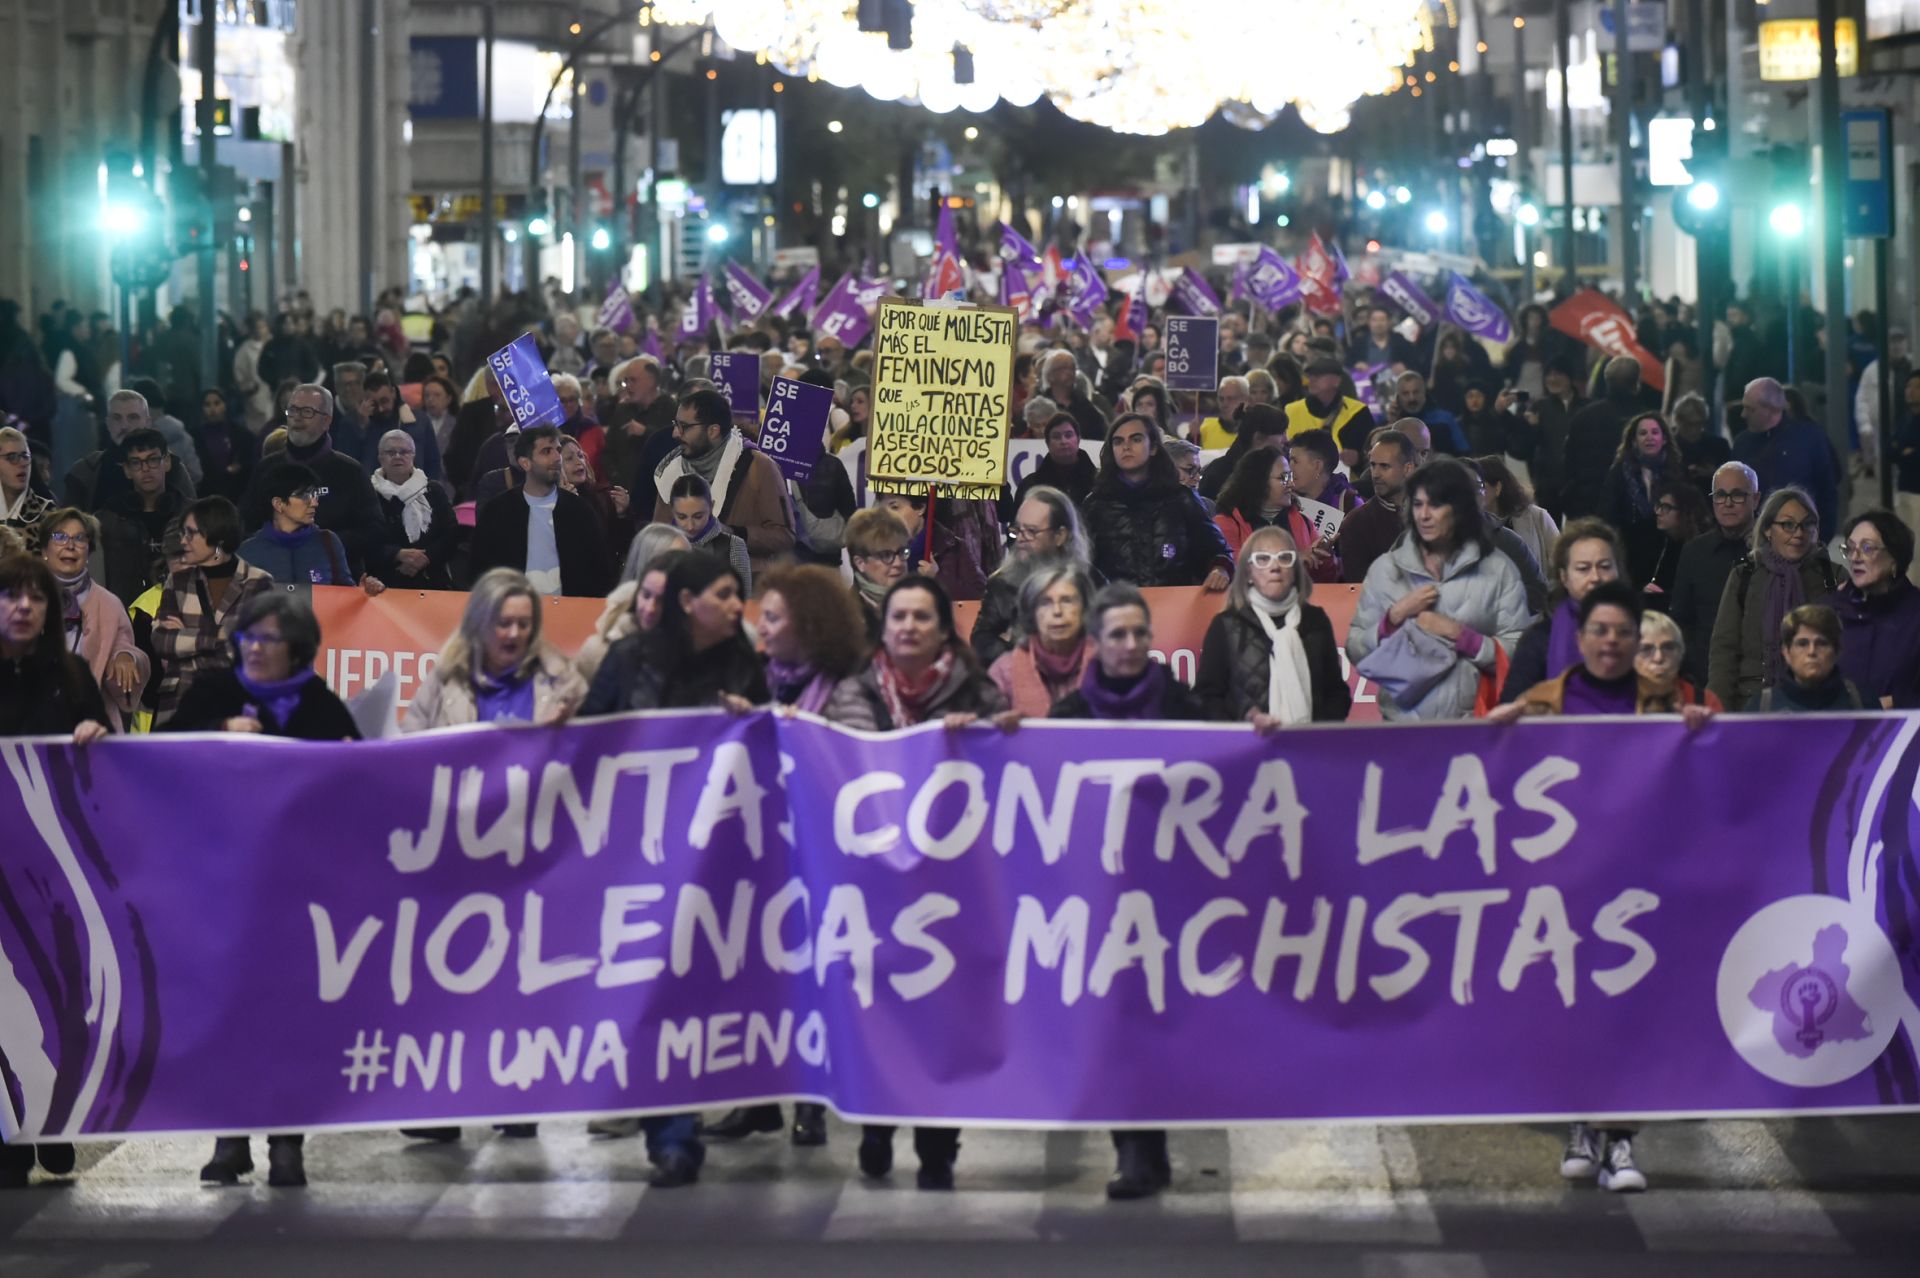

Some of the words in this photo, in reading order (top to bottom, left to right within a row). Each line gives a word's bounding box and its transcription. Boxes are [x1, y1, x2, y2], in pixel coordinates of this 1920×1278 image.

[881, 304, 916, 330] ¿POR
[919, 311, 941, 332] QUÉ
[944, 314, 1012, 346] MOLESTA
[1169, 320, 1188, 332] SE
[879, 331, 908, 355] MÁS
[914, 335, 937, 354] EL
[1168, 334, 1180, 346] A
[493, 351, 514, 372] SE
[713, 354, 731, 367] SE
[1168, 347, 1190, 360] CA
[712, 368, 723, 380] A
[878, 356, 995, 388] FEMINISMO
[1168, 359, 1190, 373] BÓ
[502, 373, 515, 389] A
[774, 381, 799, 400] SE
[509, 384, 530, 404] CA
[878, 388, 902, 404] QUE
[905, 399, 921, 412] LAS
[921, 391, 1005, 417] TRATAS
[515, 398, 536, 422] BÓ
[769, 399, 784, 415] A
[766, 417, 791, 436] CA
[876, 411, 1000, 439] VIOLACIONES
[761, 434, 788, 453] BÓ
[874, 432, 991, 459] ASESINATOS
[834, 758, 1309, 880] CONTRA
[1357, 754, 1580, 875] LAS
[309, 876, 960, 1010] VIOLENCAS
[1004, 885, 1660, 1014] MACHISTAS
[341, 1029, 465, 1093] #NI
[488, 1019, 629, 1090] UNA
[656, 1008, 832, 1082] MENO
